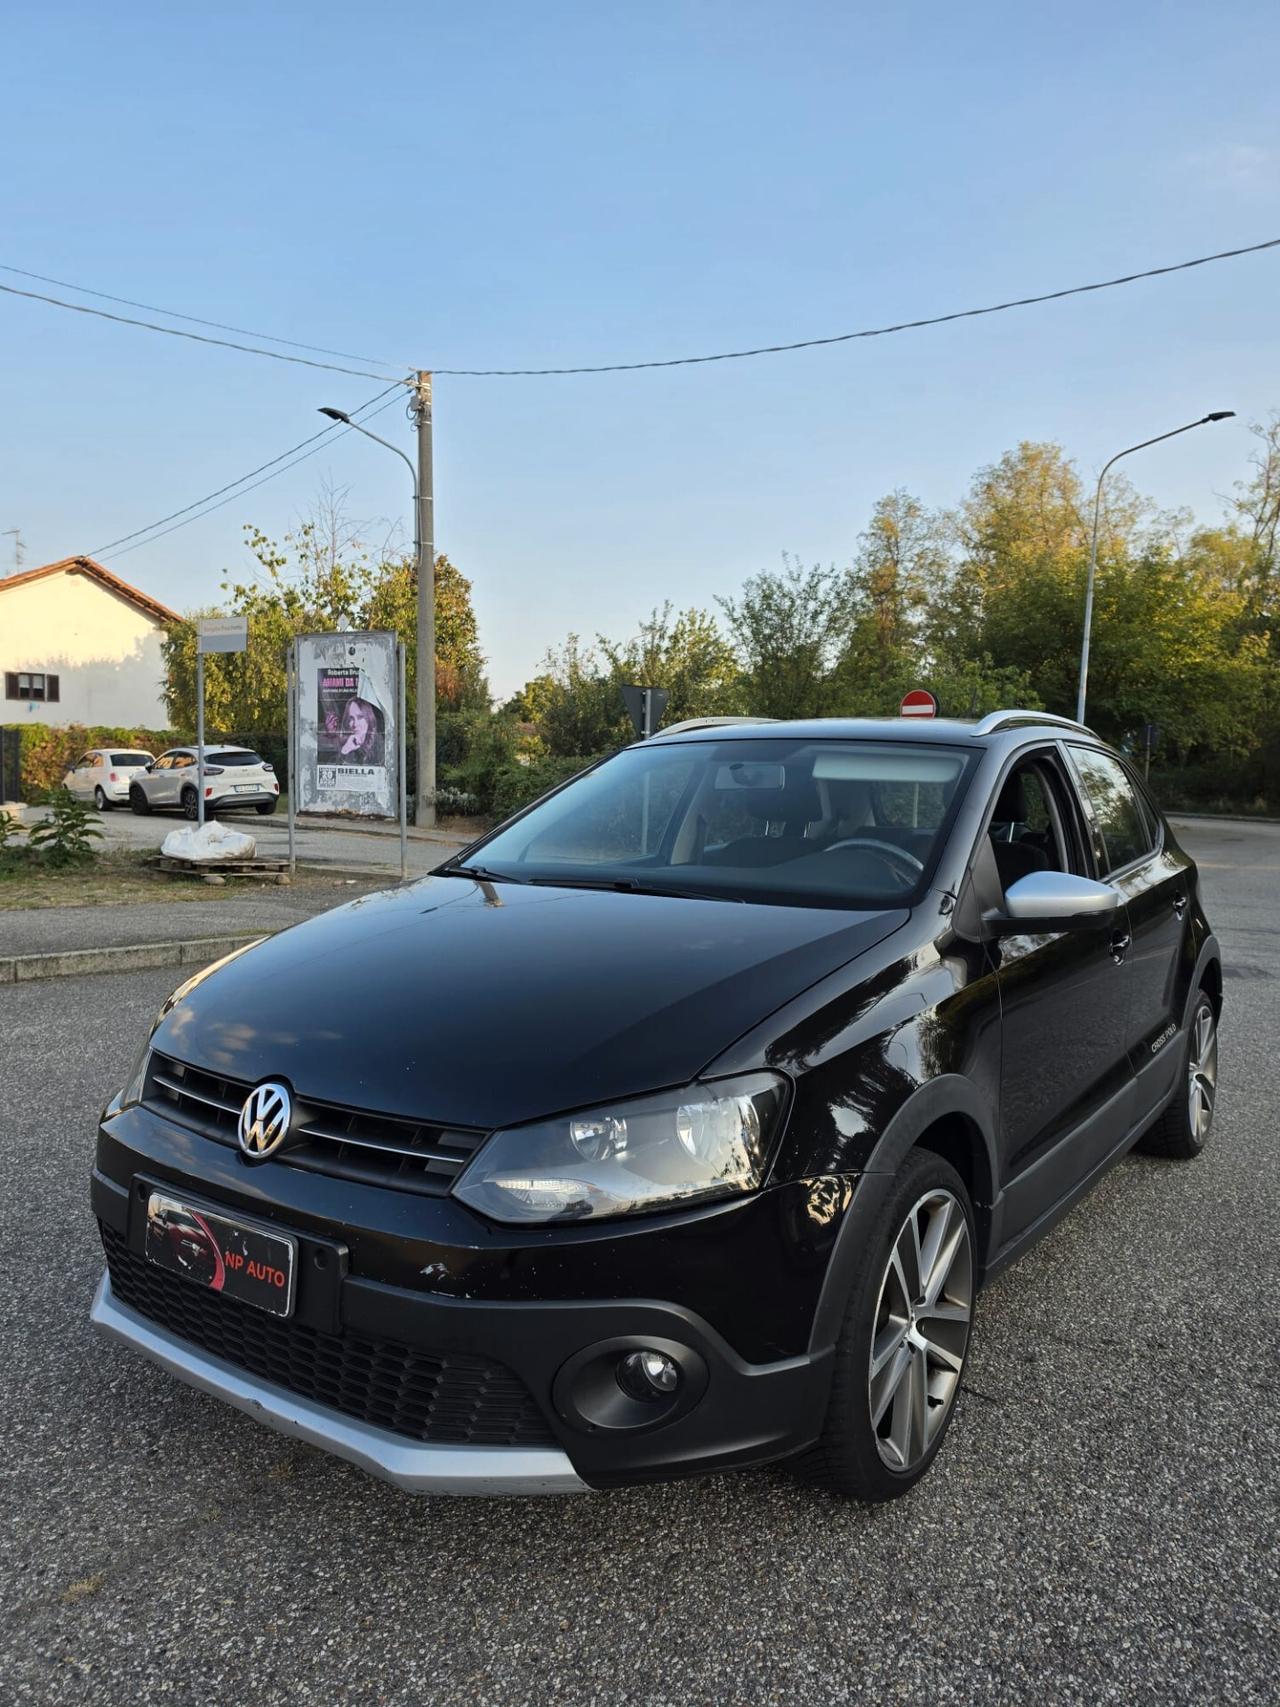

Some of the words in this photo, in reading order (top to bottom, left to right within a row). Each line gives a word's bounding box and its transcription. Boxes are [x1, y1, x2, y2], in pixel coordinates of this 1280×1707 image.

[337, 767, 375, 776] BIELLA
[239, 1084, 290, 1157] VW
[225, 1252, 244, 1270] NP
[246, 1260, 285, 1287] AUTO
